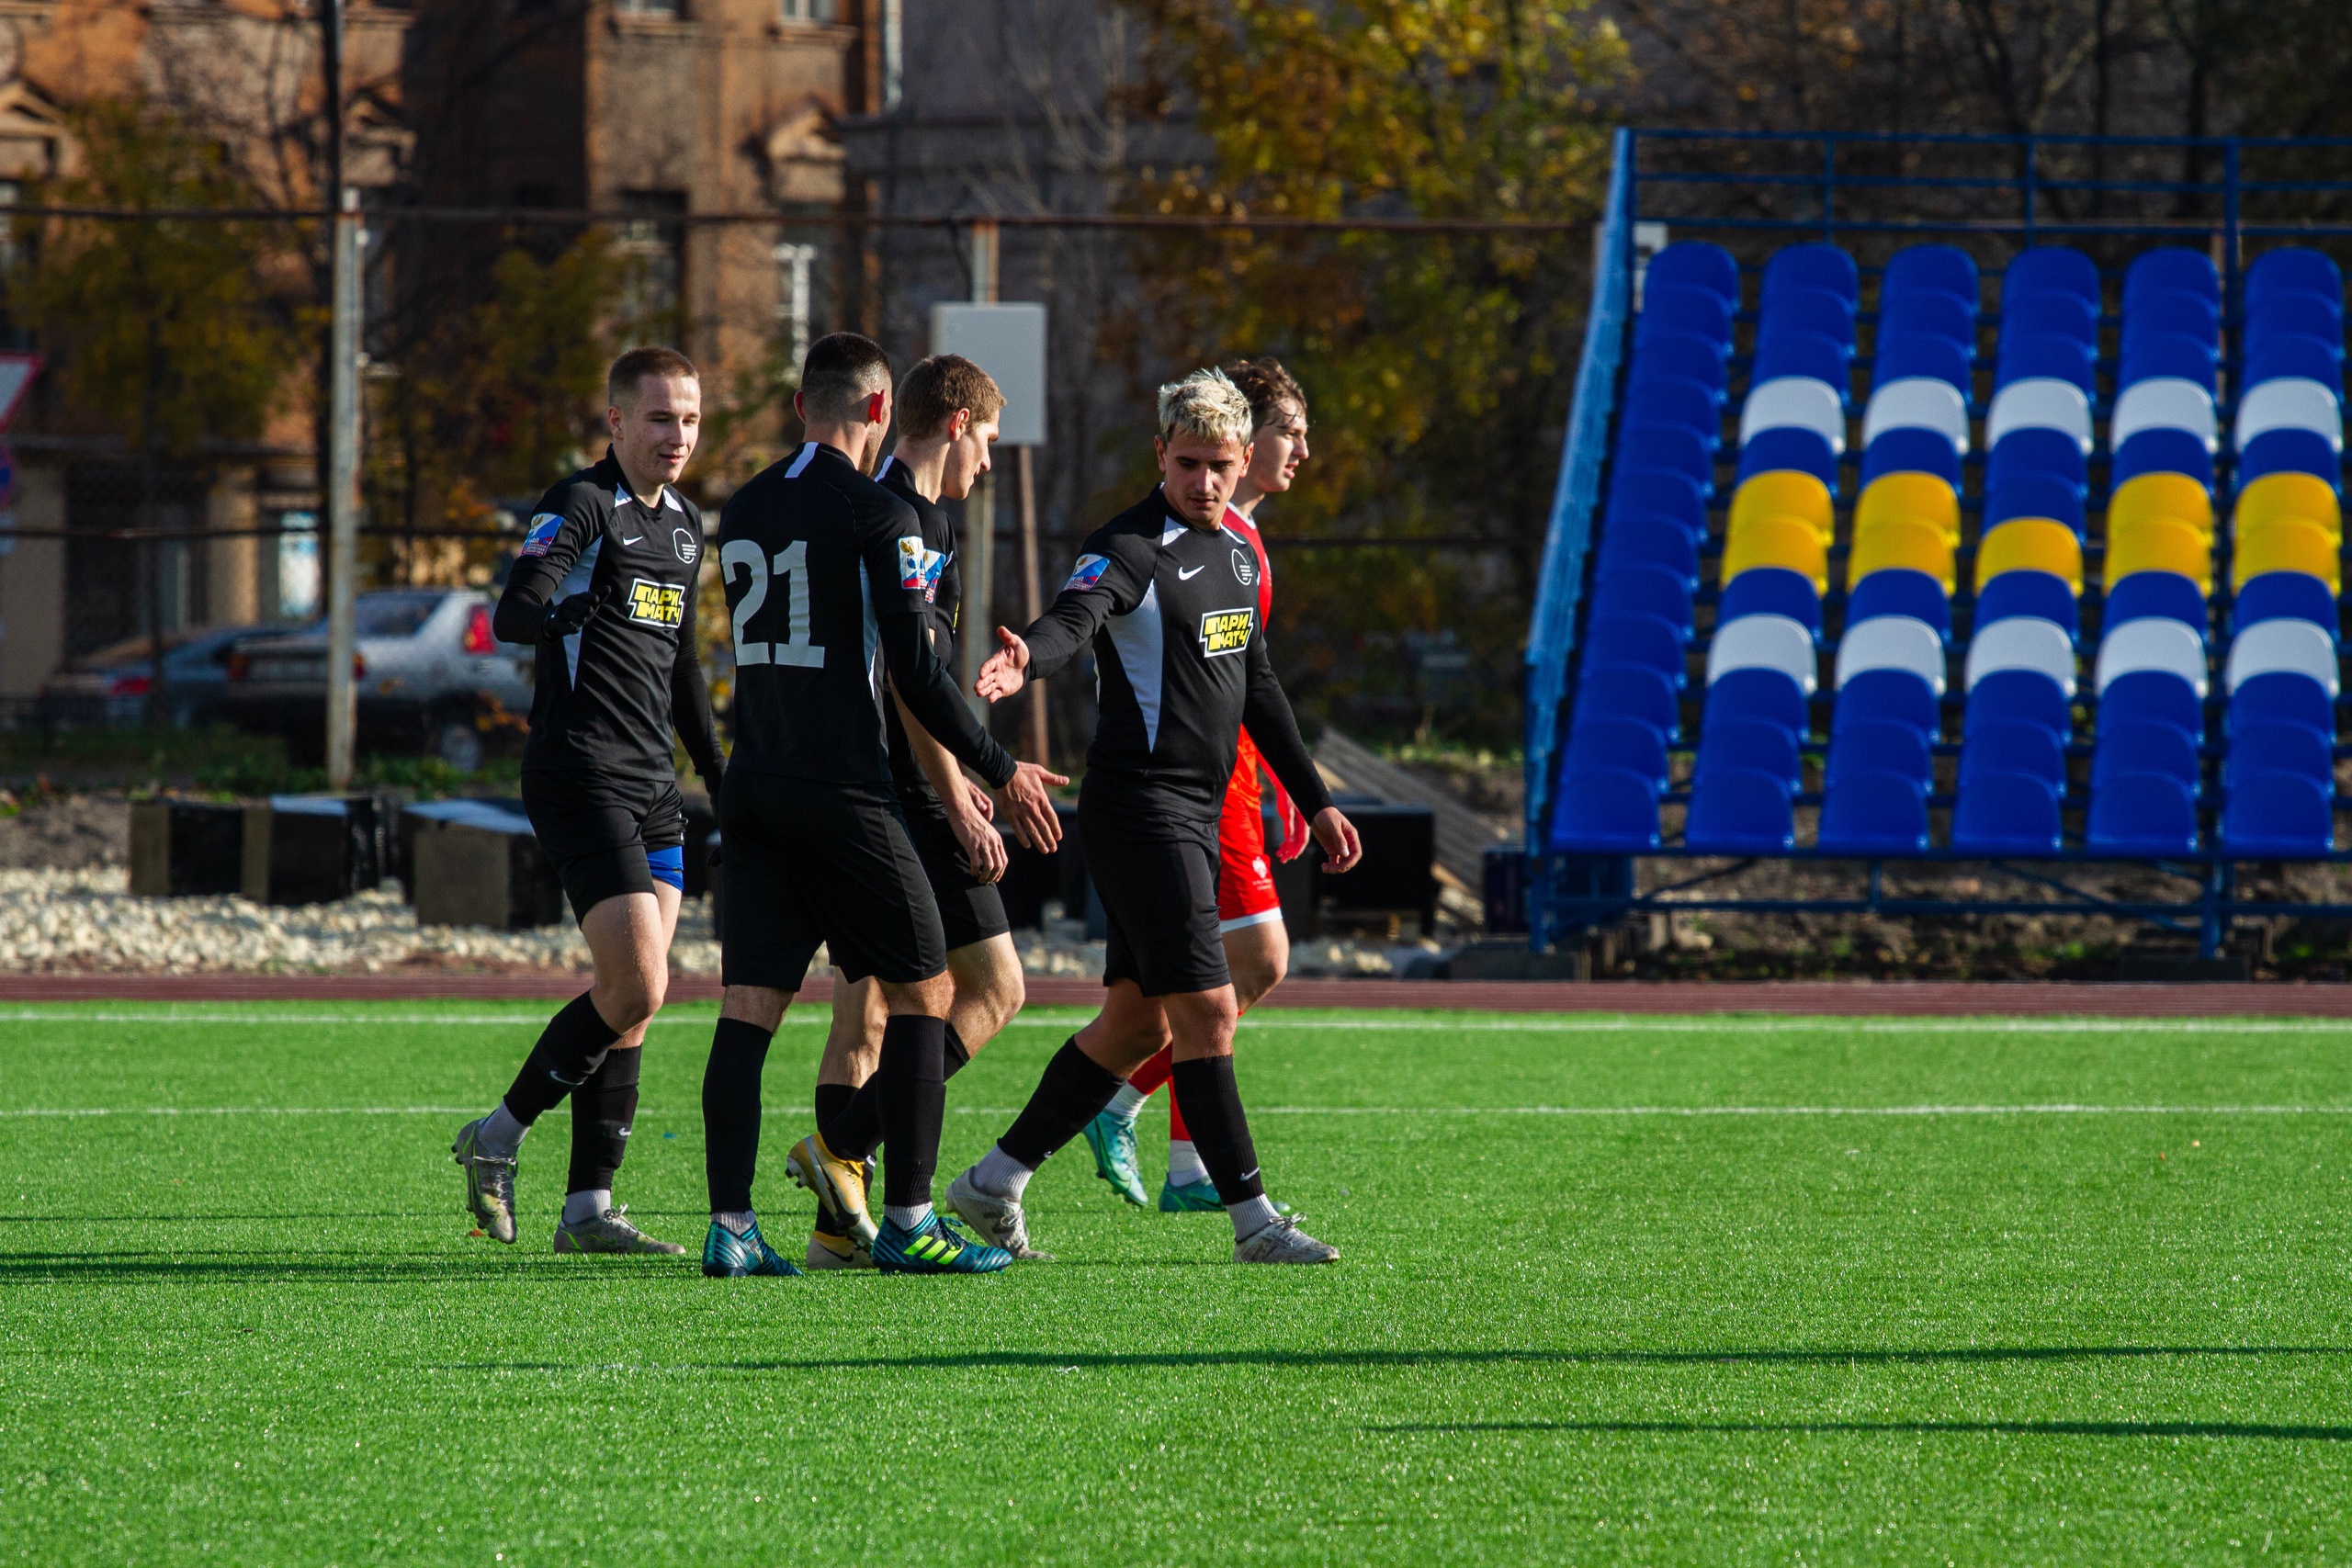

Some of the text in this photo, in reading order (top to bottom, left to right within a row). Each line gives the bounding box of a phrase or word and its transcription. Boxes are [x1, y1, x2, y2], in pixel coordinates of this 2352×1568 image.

[634, 584, 680, 606] ПАРИ
[721, 539, 825, 668] 21
[636, 601, 681, 623] МАТЧ
[1204, 614, 1250, 636] ПАРИ
[1208, 629, 1250, 650] МАТЧ
